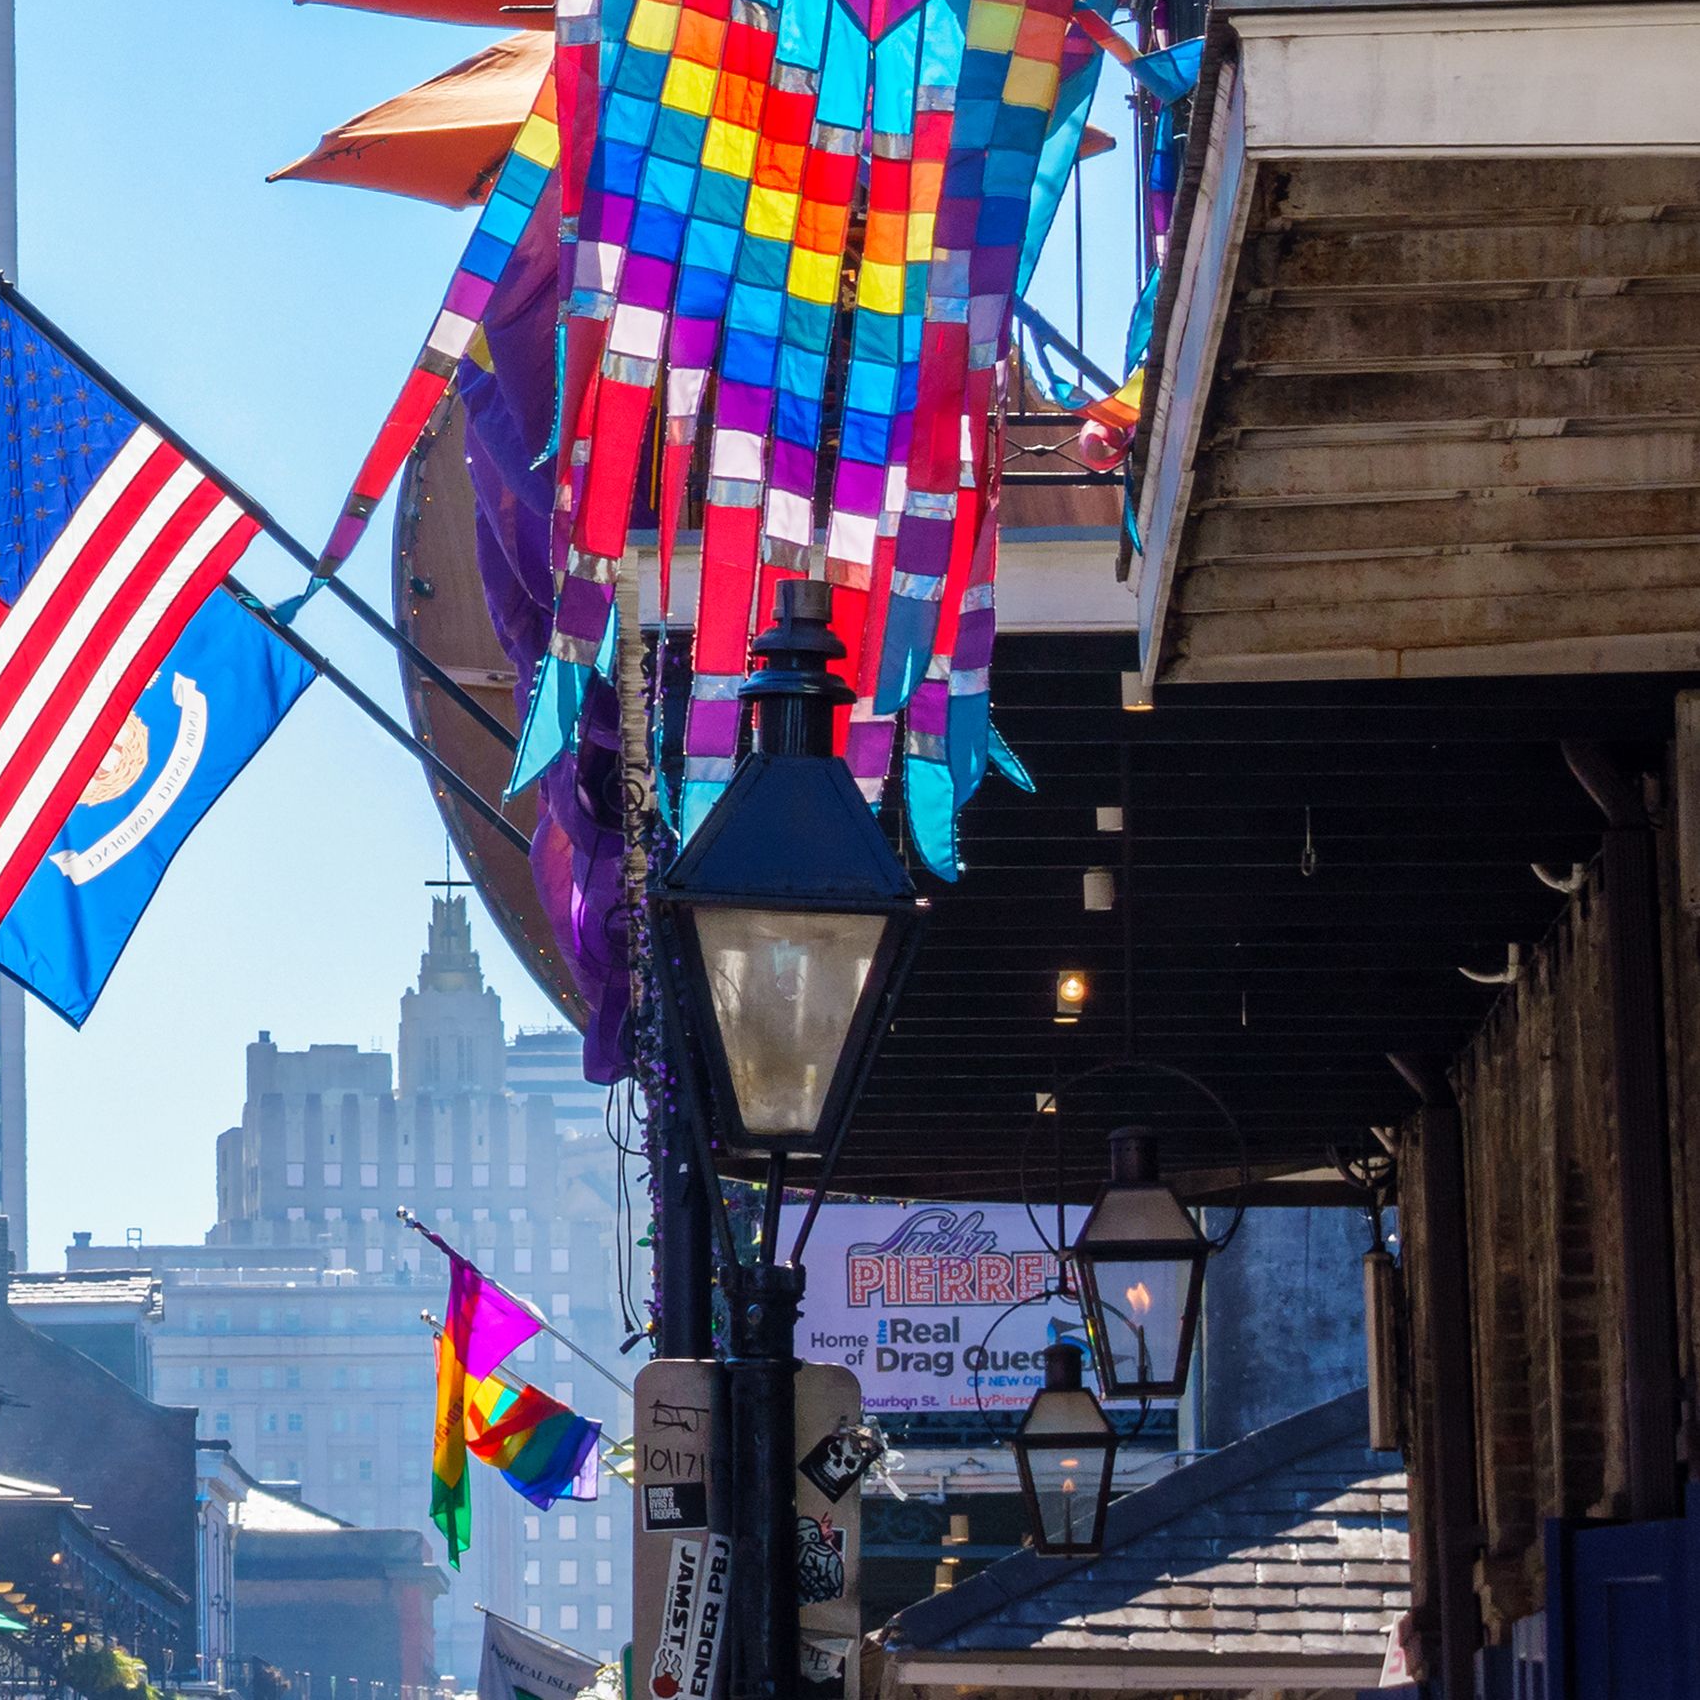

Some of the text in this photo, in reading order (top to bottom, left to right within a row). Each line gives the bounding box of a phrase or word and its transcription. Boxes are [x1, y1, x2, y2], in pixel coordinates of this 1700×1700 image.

[847, 1208, 998, 1262] Lucky
[811, 1316, 960, 1348] Home the Real
[845, 1345, 1048, 1377] of Drag Quee
[966, 1375, 985, 1388] OF
[989, 1375, 1019, 1388] NEW
[921, 1395, 939, 1407] St.
[707, 1539, 730, 1594] PBJ
